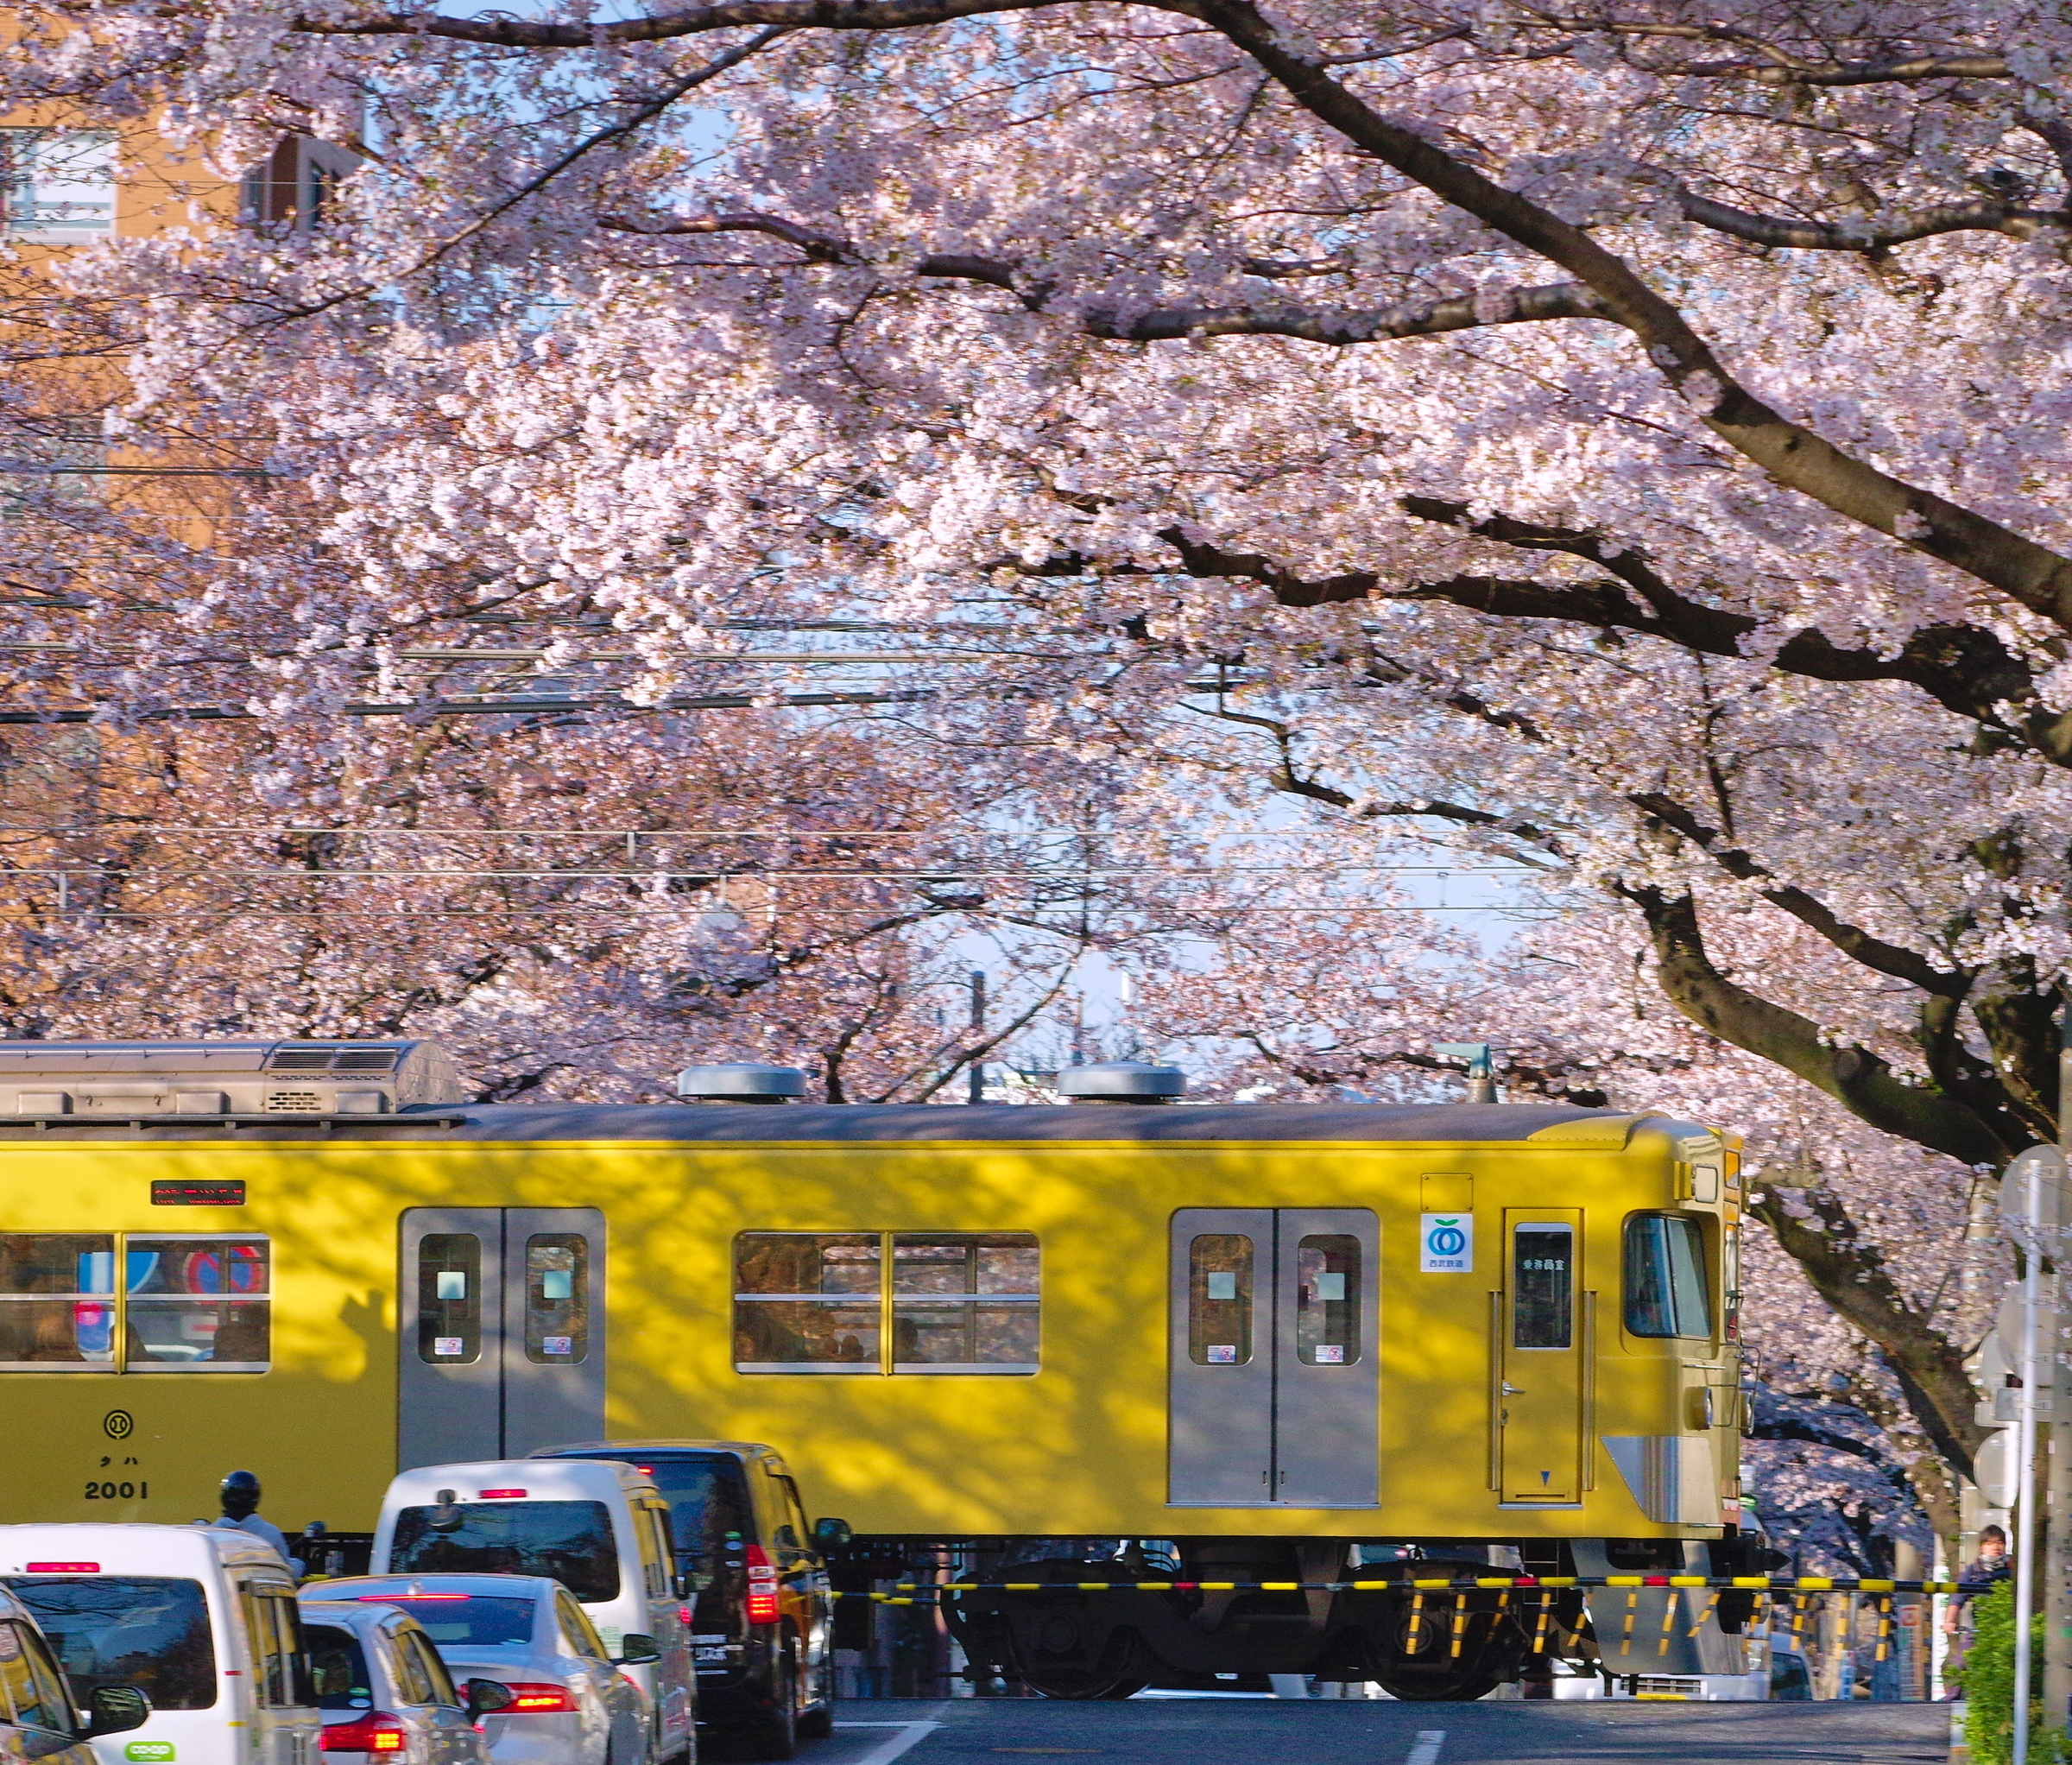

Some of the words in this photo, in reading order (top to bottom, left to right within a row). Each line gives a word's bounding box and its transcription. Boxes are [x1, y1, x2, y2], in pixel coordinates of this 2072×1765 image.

[1429, 1259, 1463, 1268] 西武鉄道
[1523, 1259, 1564, 1270] 乗務員室
[85, 1482, 148, 1499] 2001
